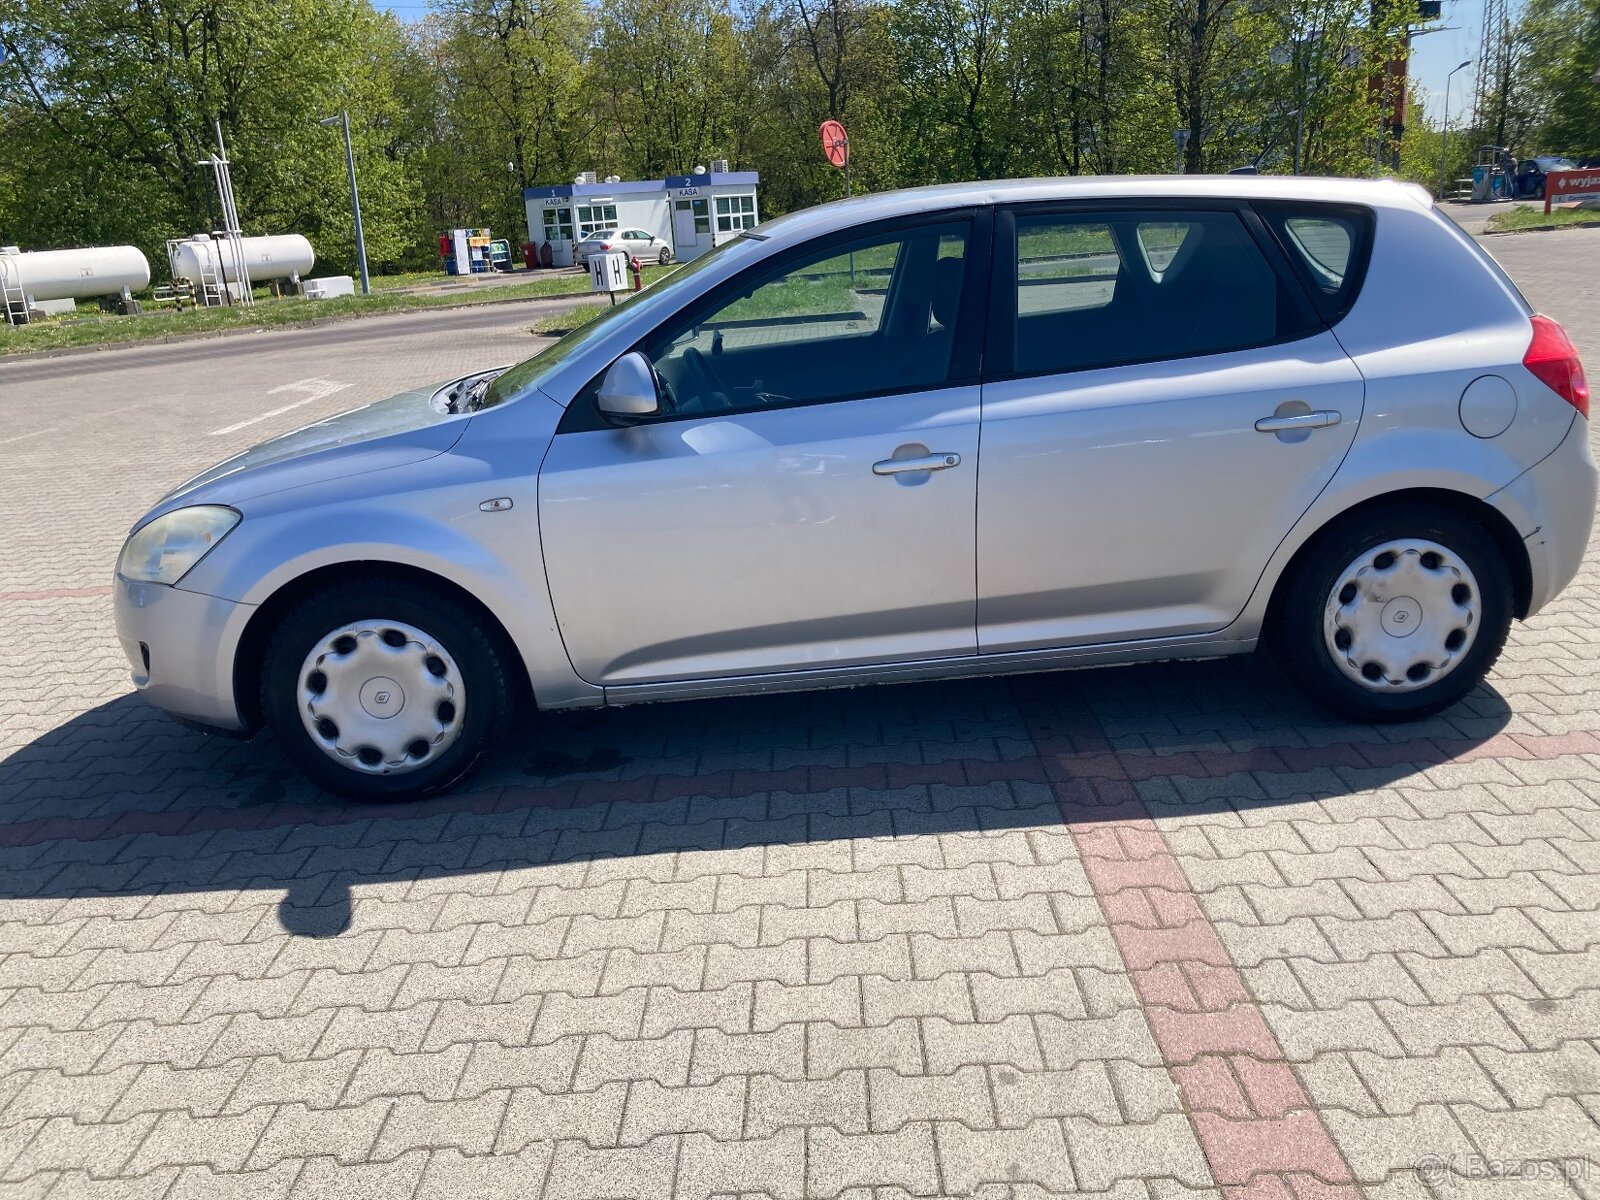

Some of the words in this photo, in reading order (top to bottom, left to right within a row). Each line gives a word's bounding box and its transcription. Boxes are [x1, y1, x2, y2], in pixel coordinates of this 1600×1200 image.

[685, 178, 691, 187] 2
[551, 189, 556, 197] 1
[679, 188, 698, 197] KASA
[545, 198, 562, 206] KASA
[593, 260, 604, 286] H
[612, 256, 623, 285] H
